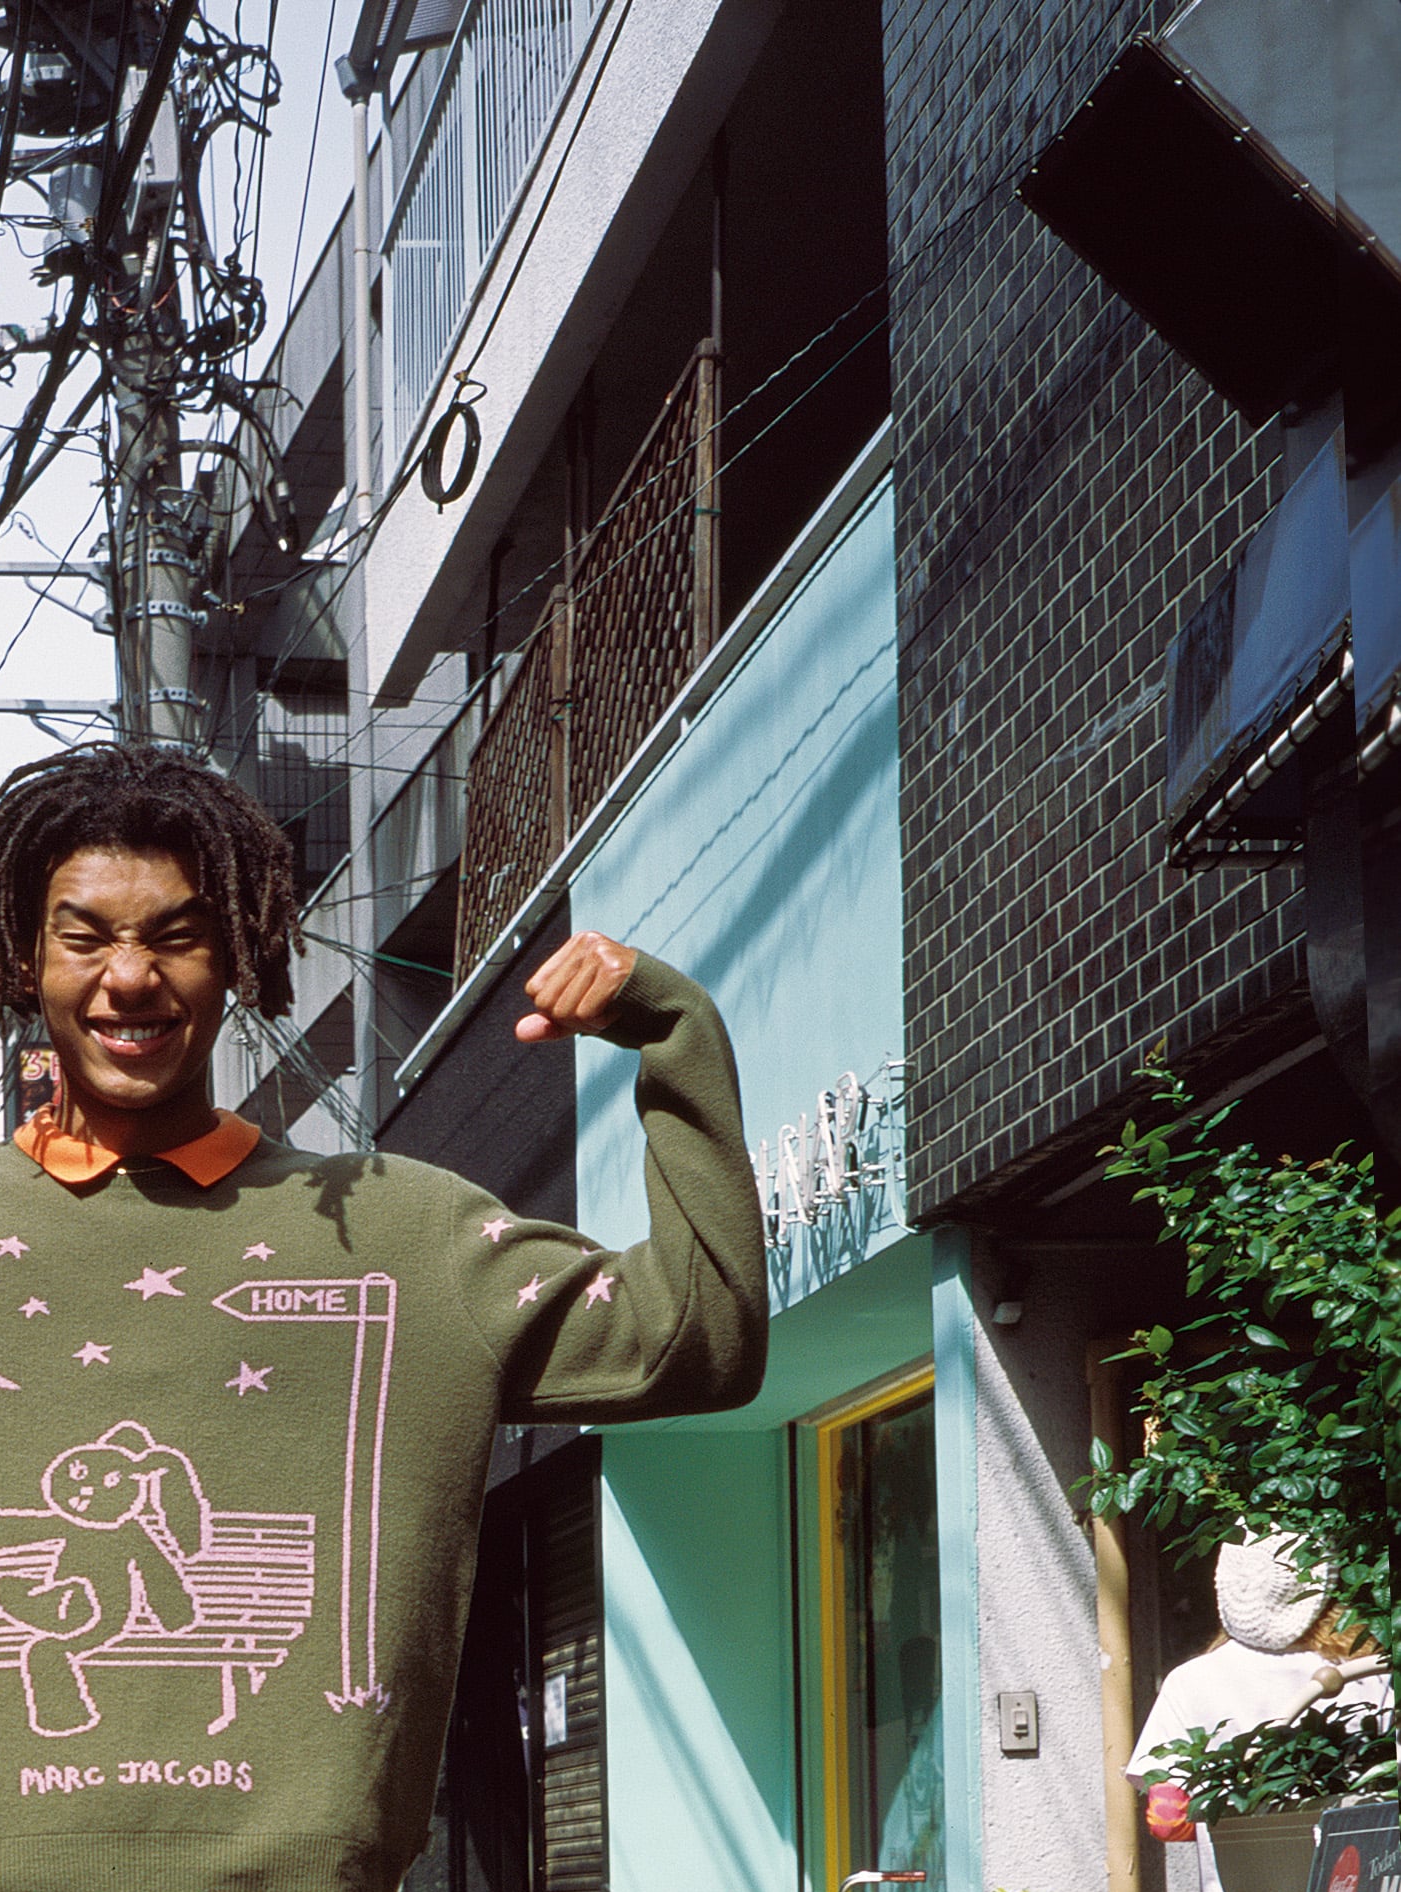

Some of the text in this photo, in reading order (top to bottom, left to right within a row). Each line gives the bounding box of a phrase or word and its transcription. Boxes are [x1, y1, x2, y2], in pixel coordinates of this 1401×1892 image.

[251, 1288, 347, 1313] HOME
[20, 1759, 254, 1795] MARC JACOBS
